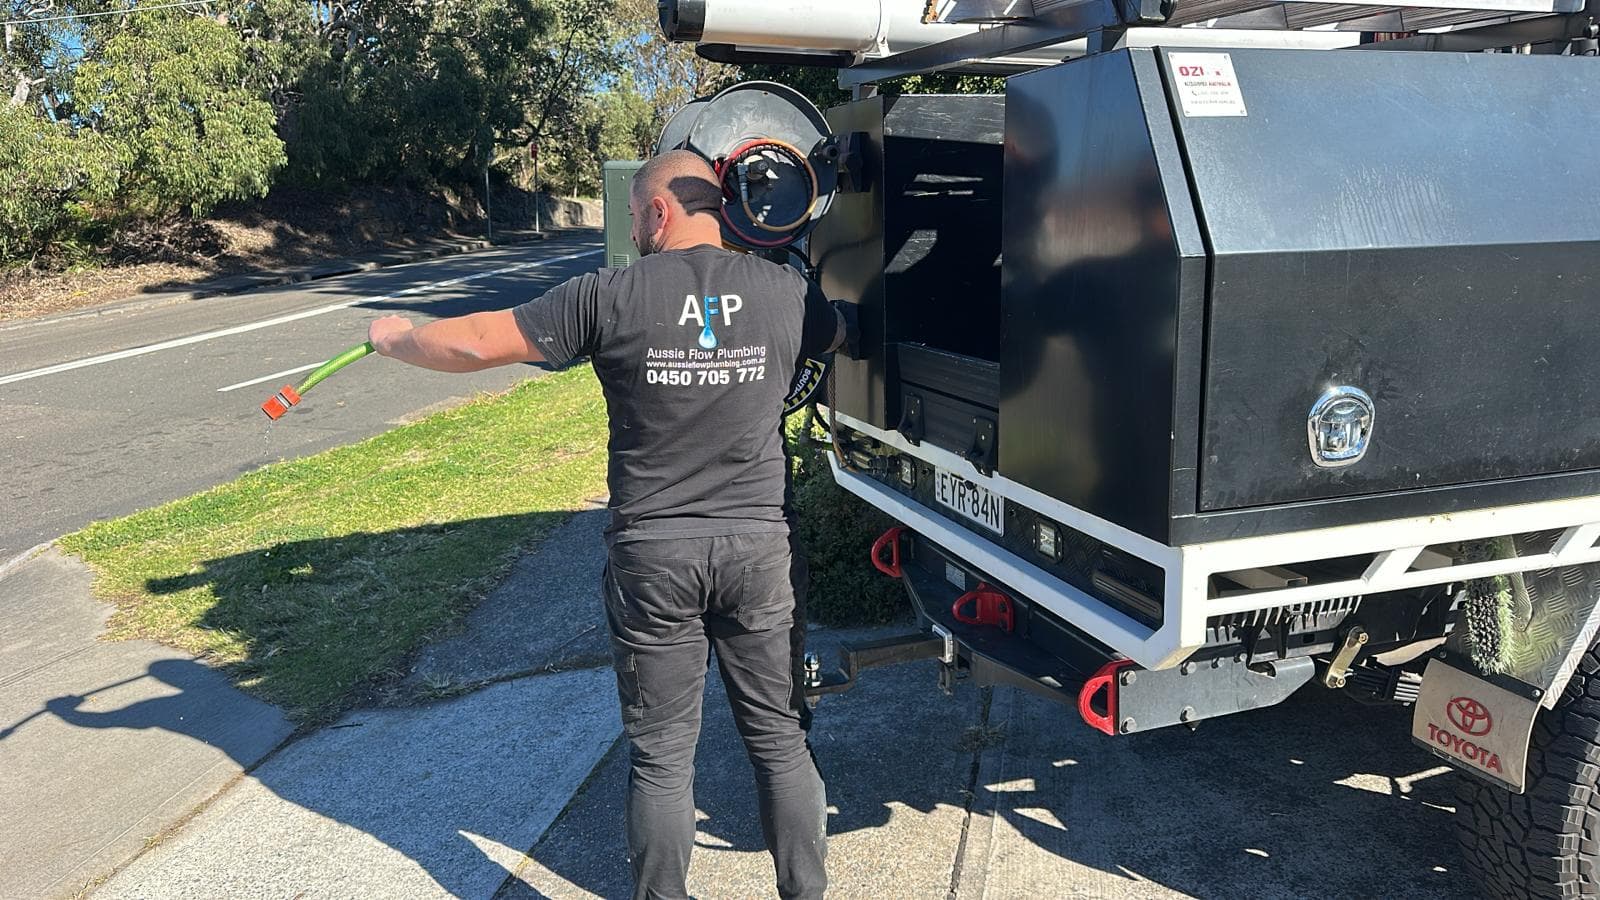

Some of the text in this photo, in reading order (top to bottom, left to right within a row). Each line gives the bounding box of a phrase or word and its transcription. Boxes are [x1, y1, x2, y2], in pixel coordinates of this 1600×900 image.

[678, 294, 743, 328] AFP
[646, 345, 766, 360] Aussie Flow Plumbing
[646, 357, 766, 370] www.aussieflowplumbing.com.au
[646, 365, 765, 386] 0450 705 772
[1427, 722, 1503, 774] TOYOTA
